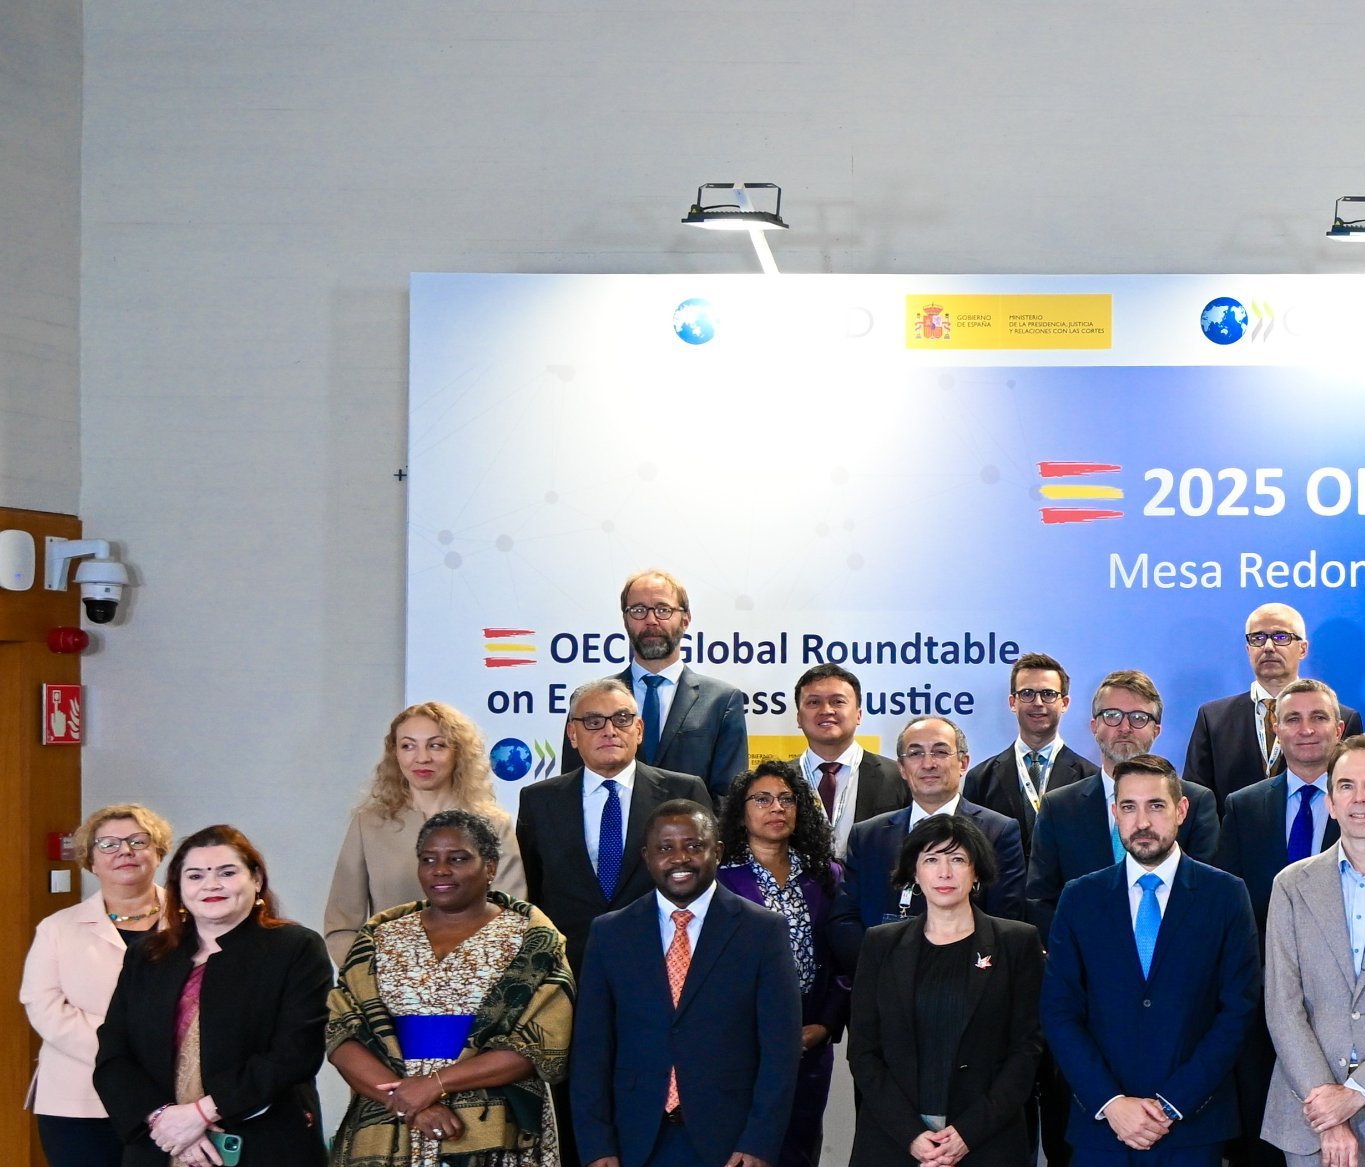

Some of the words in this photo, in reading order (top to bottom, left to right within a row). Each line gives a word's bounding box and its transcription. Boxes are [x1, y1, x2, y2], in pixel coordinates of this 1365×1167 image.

[968, 320, 991, 328] ESPAÑA
[1143, 465, 1286, 517] 2025
[1109, 553, 1223, 589] Mesa
[550, 633, 638, 663] OEC
[802, 632, 1020, 664] Roundtable
[487, 690, 534, 714] on
[866, 684, 974, 715] ustice
